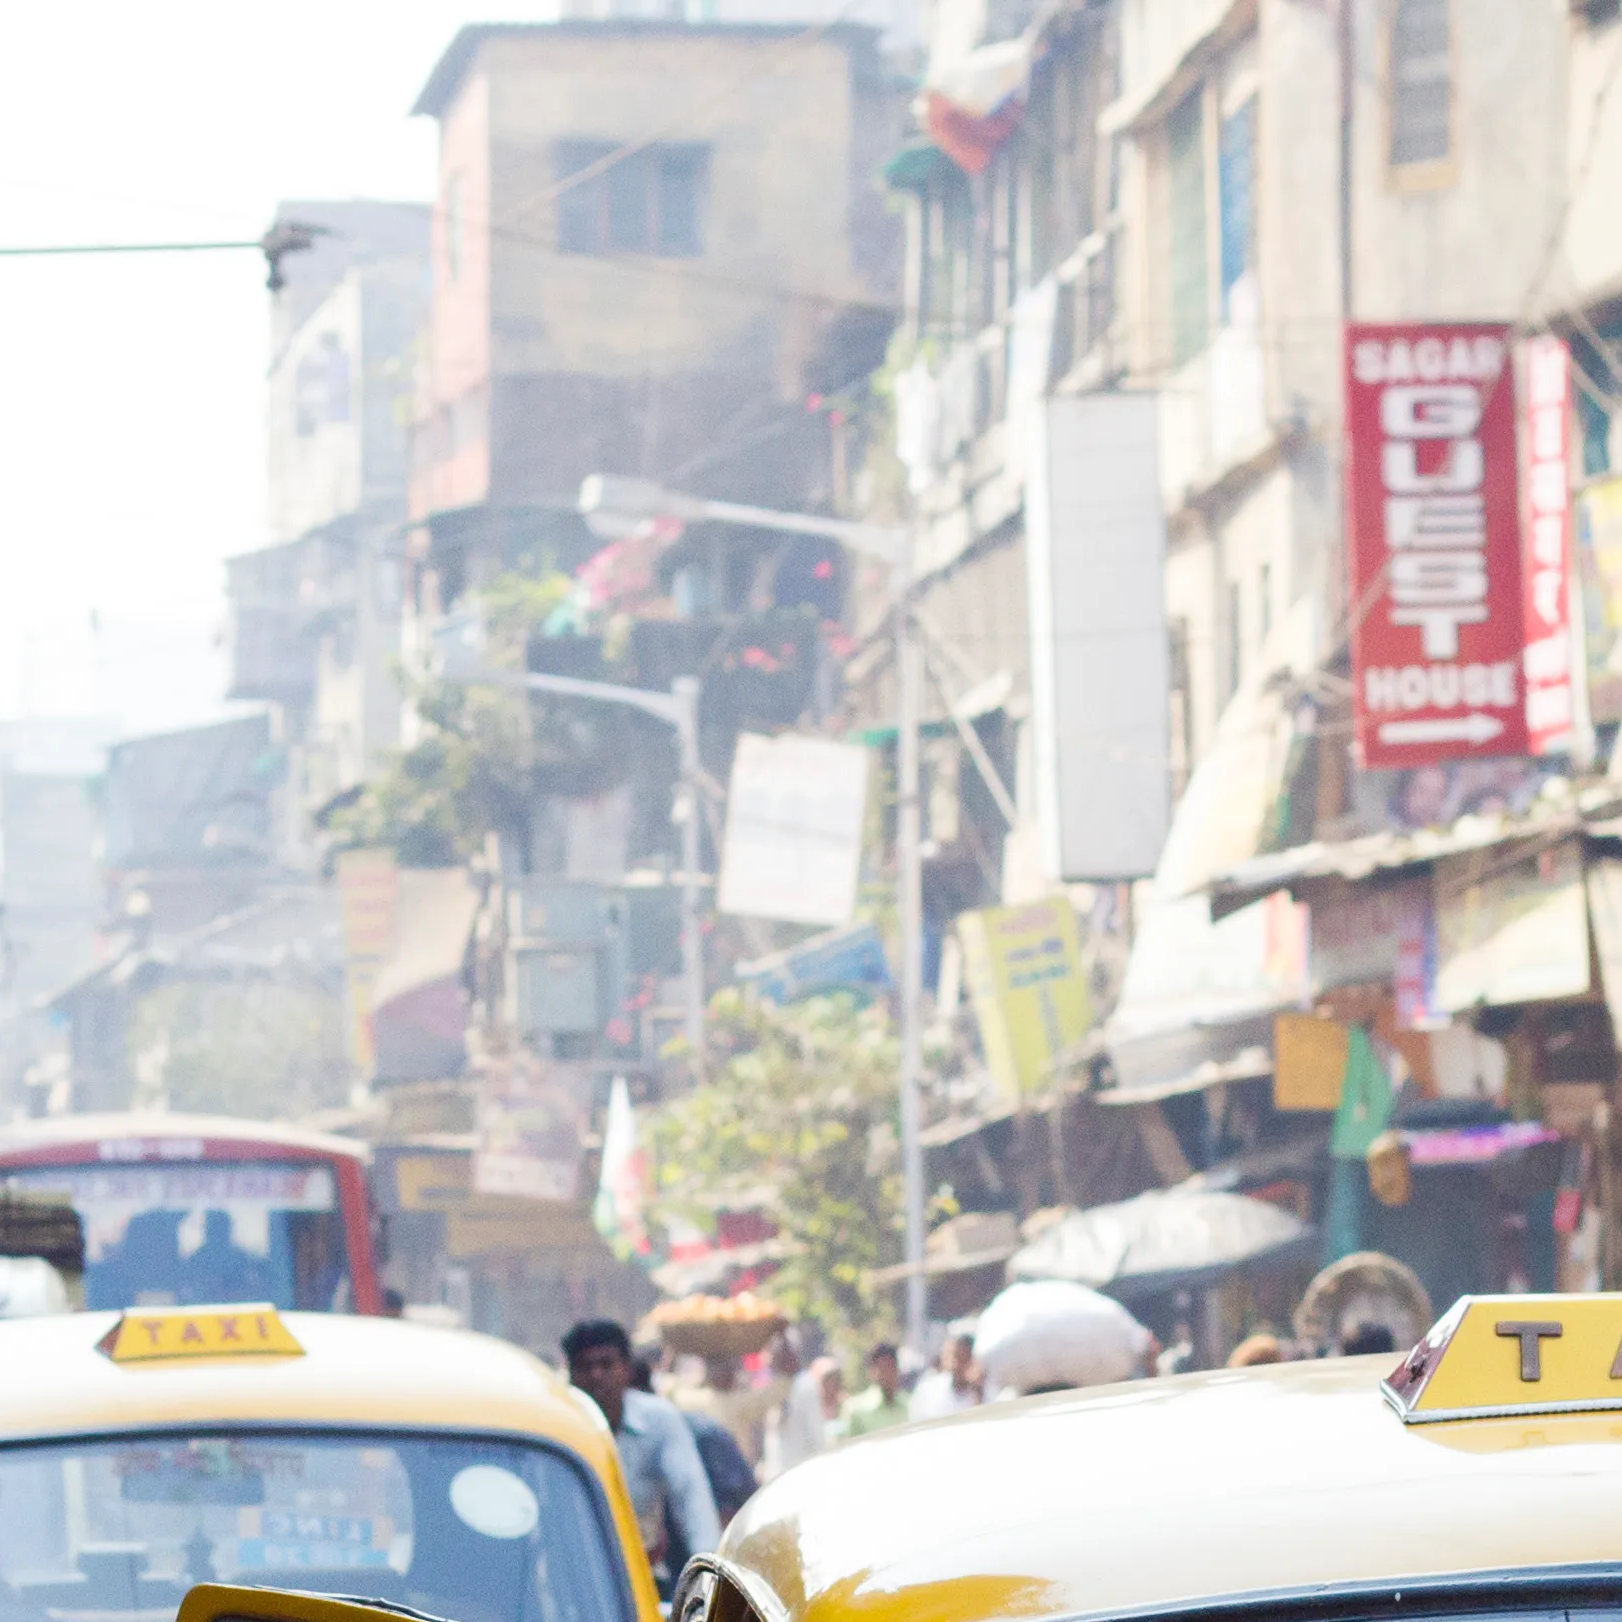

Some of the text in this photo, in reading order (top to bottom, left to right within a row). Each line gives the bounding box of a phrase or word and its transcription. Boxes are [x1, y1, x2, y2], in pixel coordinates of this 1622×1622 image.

[1350, 334, 1507, 385] SAGAR
[1380, 384, 1491, 662] GUEST
[1363, 661, 1519, 712] HOUSE
[140, 1314, 269, 1345] TAXI
